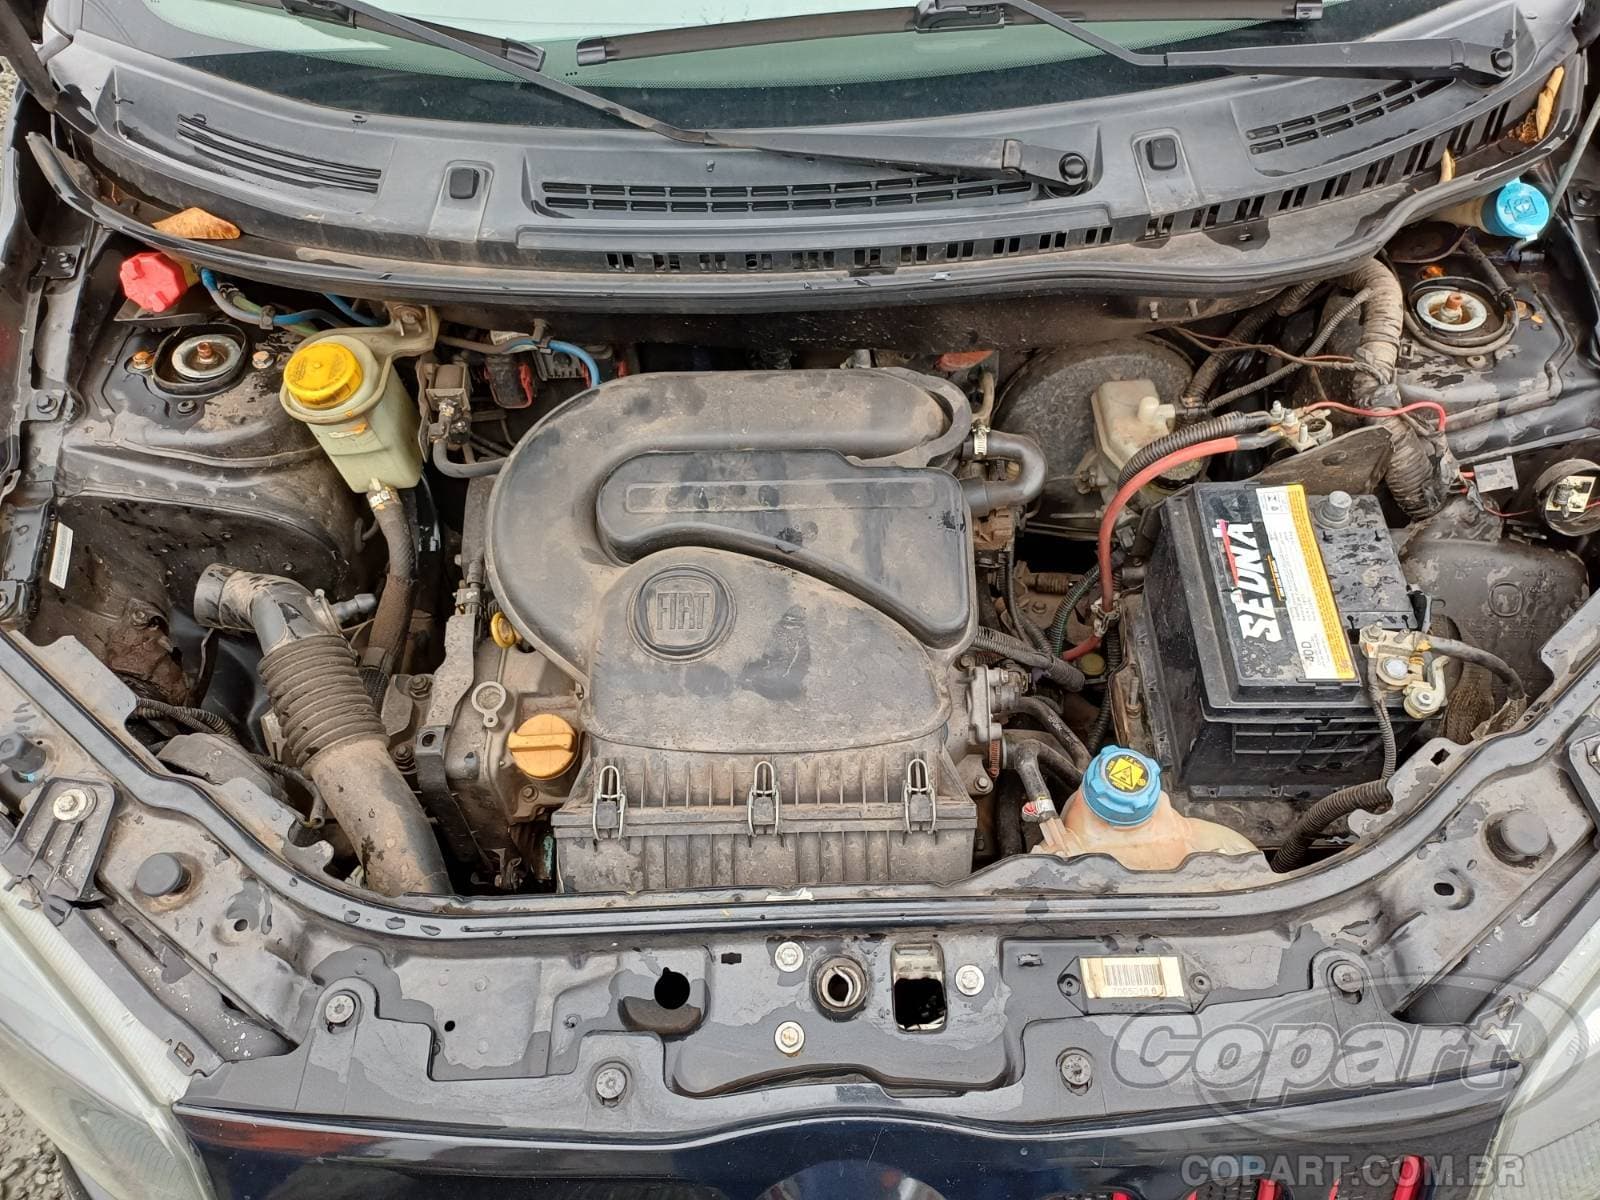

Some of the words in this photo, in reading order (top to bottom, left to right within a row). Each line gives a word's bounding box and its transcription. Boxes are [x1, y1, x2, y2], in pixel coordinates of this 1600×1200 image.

[1213, 520, 1282, 642] SEDNA
[657, 592, 710, 630] FIAT
[1301, 641, 1314, 662] 40D
